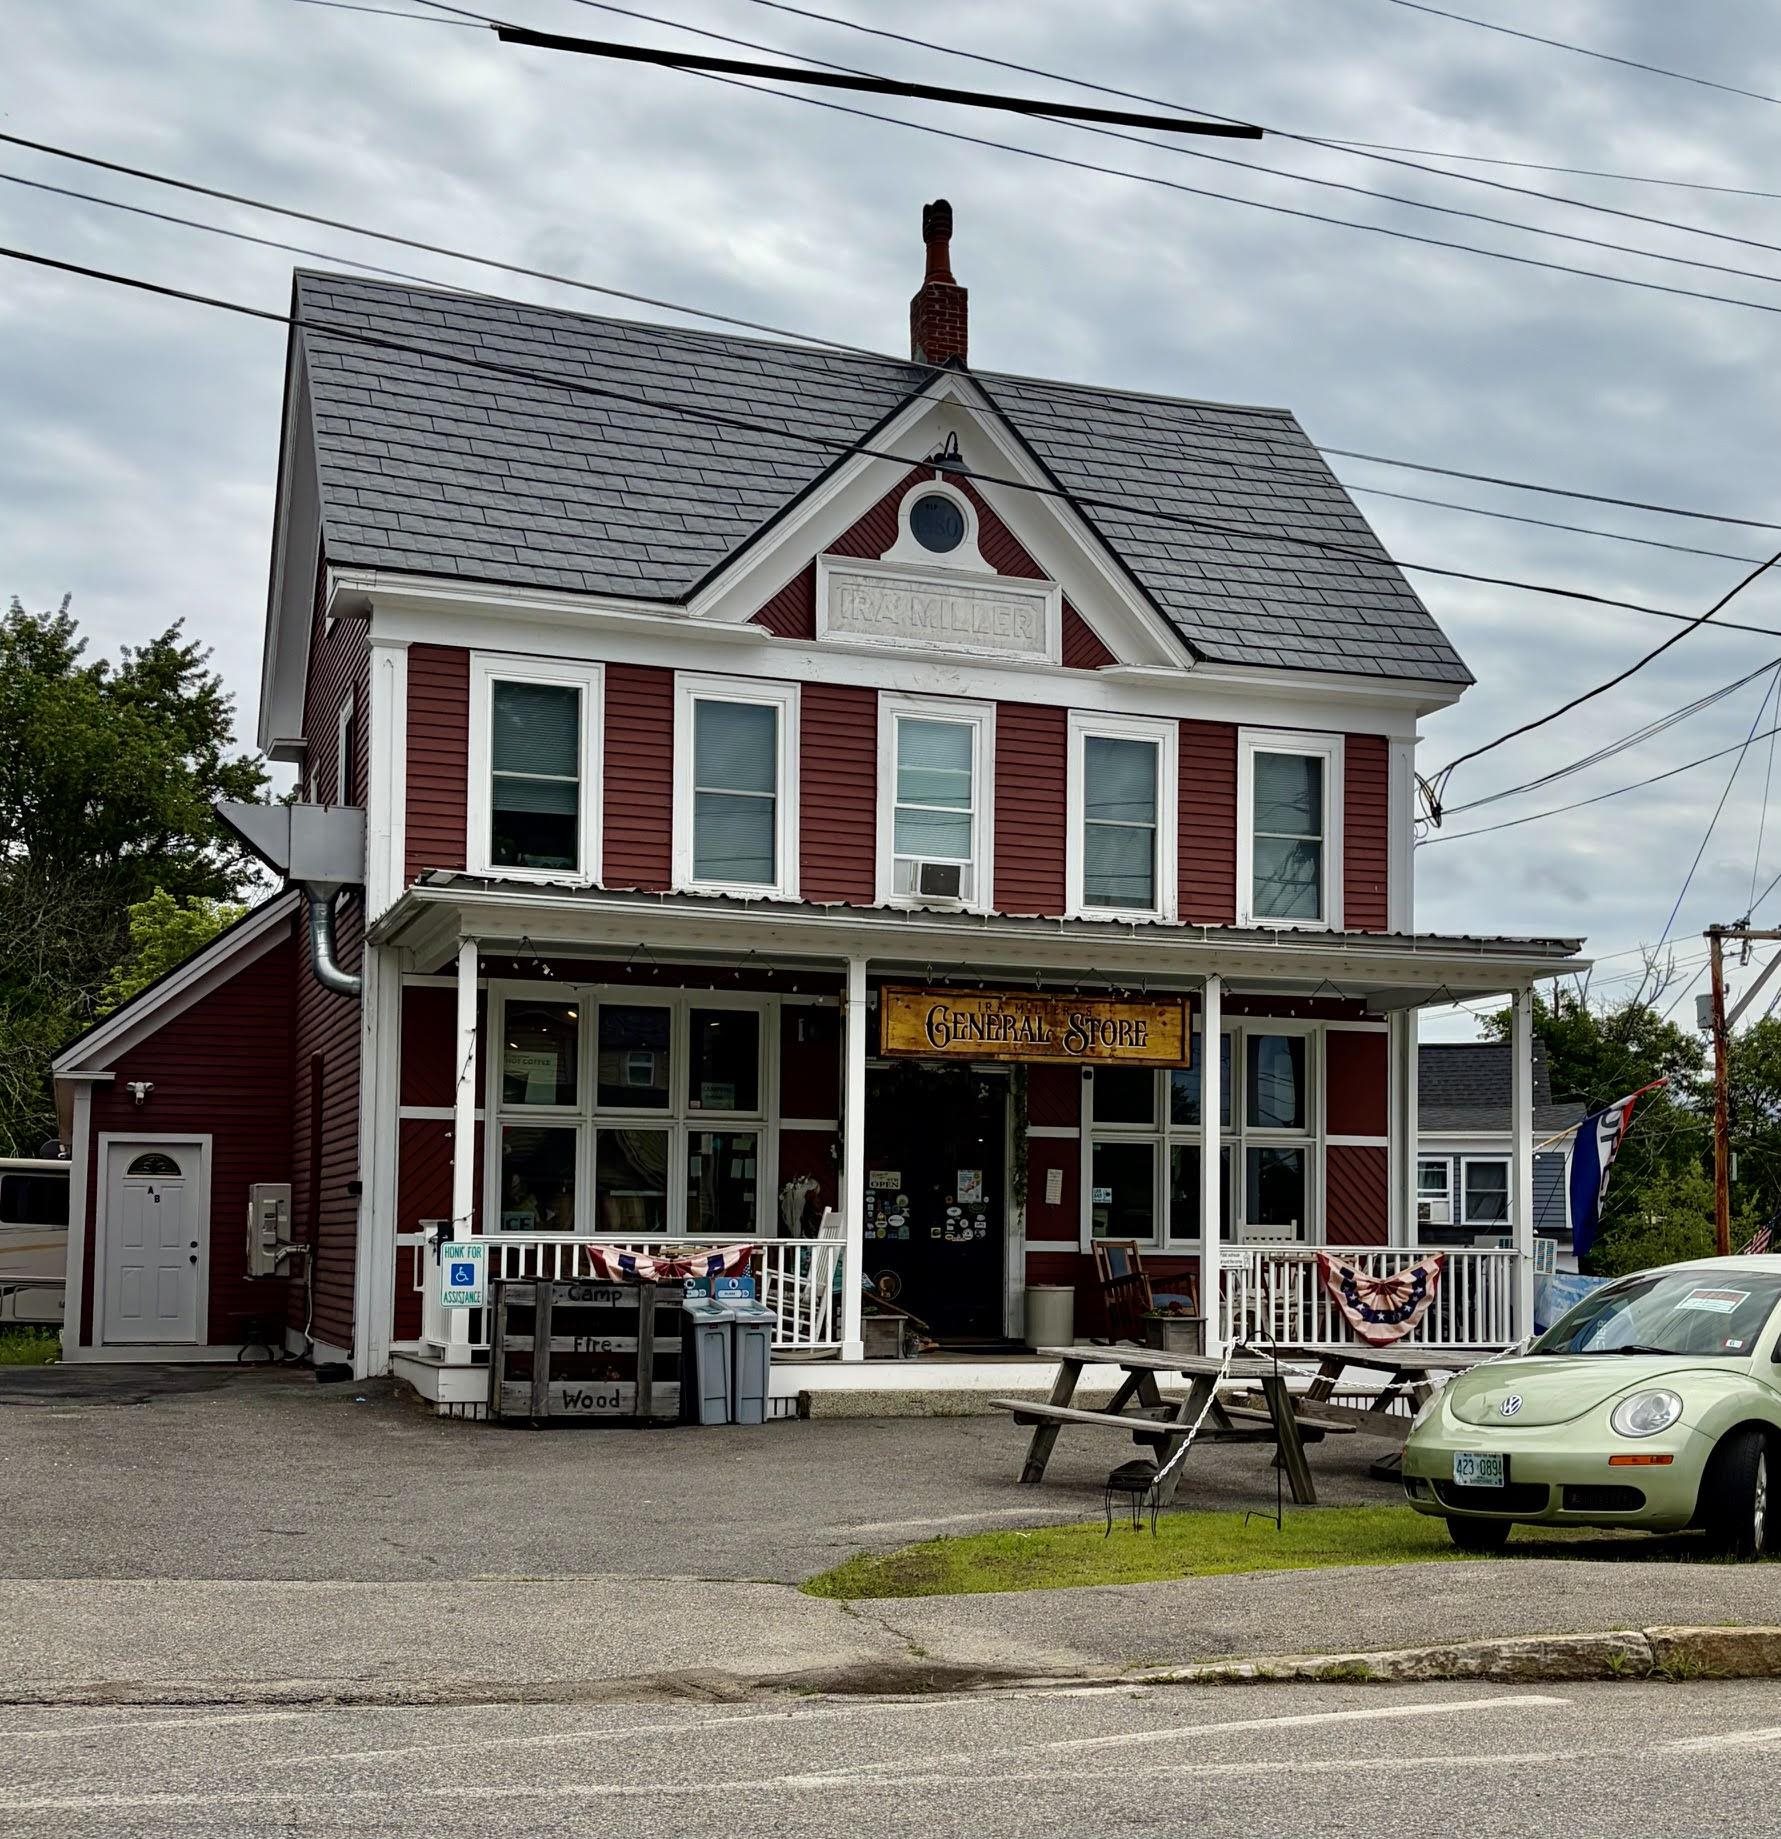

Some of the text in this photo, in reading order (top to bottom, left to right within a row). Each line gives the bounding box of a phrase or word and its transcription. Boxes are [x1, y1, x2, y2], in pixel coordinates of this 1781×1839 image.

[840, 587, 1033, 639] IRA MILLER
[977, 1001, 1005, 1013] IRA
[925, 1004, 1149, 1056] GENERAL STORE
[147, 1185, 154, 1194] A
[154, 1194, 160, 1203] B
[444, 1246, 482, 1259] HONK FOR
[443, 1290, 481, 1304] ASSISTANCE
[567, 1286, 622, 1308] Camp
[562, 1389, 620, 1409] Wood
[1456, 1459, 1475, 1476] 423
